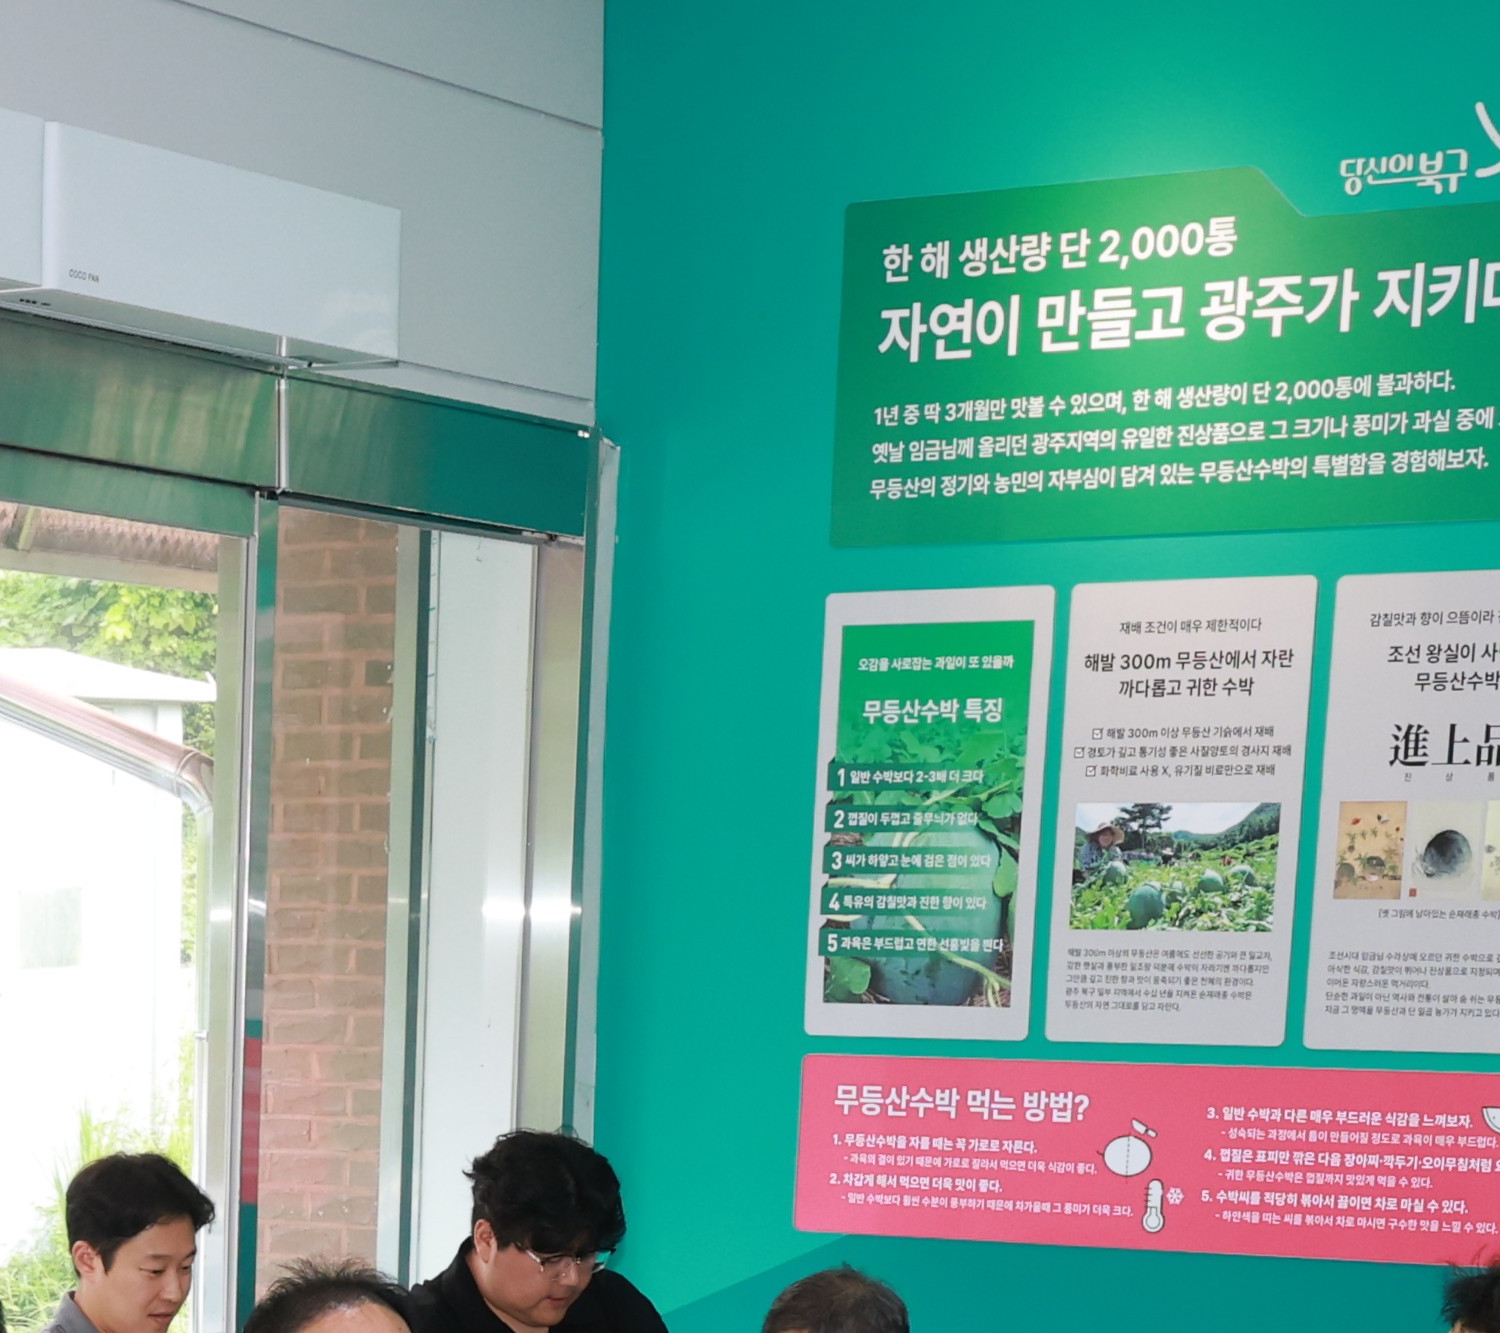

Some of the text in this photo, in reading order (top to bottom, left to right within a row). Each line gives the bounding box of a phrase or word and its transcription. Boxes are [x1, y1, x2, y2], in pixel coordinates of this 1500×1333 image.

[1339, 148, 1469, 196] 당신의 북구
[882, 216, 1238, 283] 한 해 생산량 단 2,000통
[878, 294, 1020, 362] 자연이
[1036, 285, 1185, 353] 만들고
[1199, 267, 1360, 341] 광주가
[874, 369, 1455, 426] 1년 중 딱 3개월만 맛볼 수 있으며, 한 해 생산량이 단 2,000통에 불과하다.
[871, 440, 905, 463] 옛날
[908, 436, 974, 461] 임금님께
[977, 433, 1027, 458] 올리던
[1031, 428, 1117, 455] 광주지역의
[1120, 425, 1174, 450] 유일한
[1176, 420, 1266, 447] 진상품으로
[1269, 419, 1289, 439] 그
[1291, 414, 1349, 439] 크기나
[1352, 411, 1409, 437] 풍미가
[1411, 408, 1450, 433] 과실
[1455, 405, 1495, 431] 중에
[869, 446, 1488, 500] 무등산의 정기와 농민의 자부심이 담겨 있는 무등산수박의 특별함을 경험해보자.
[1119, 617, 1262, 635] 재배 조건이 매우 제한적이다
[1369, 611, 1416, 627] 감칠맛과
[1420, 611, 1443, 626] 향이
[1445, 609, 1495, 625] 으뜸이라
[1084, 648, 1294, 672] 해발 300m 무등산에서 자란
[1387, 644, 1420, 664] 조선
[1425, 642, 1476, 664] 왕실이
[1118, 676, 1254, 698] 까다롭고 귀한 수박
[1414, 670, 1500, 692] 무등산수박
[862, 697, 1003, 724] 무등산수박 특징
[834, 1085, 1089, 1122] 무등산수박 먹는 방법?
